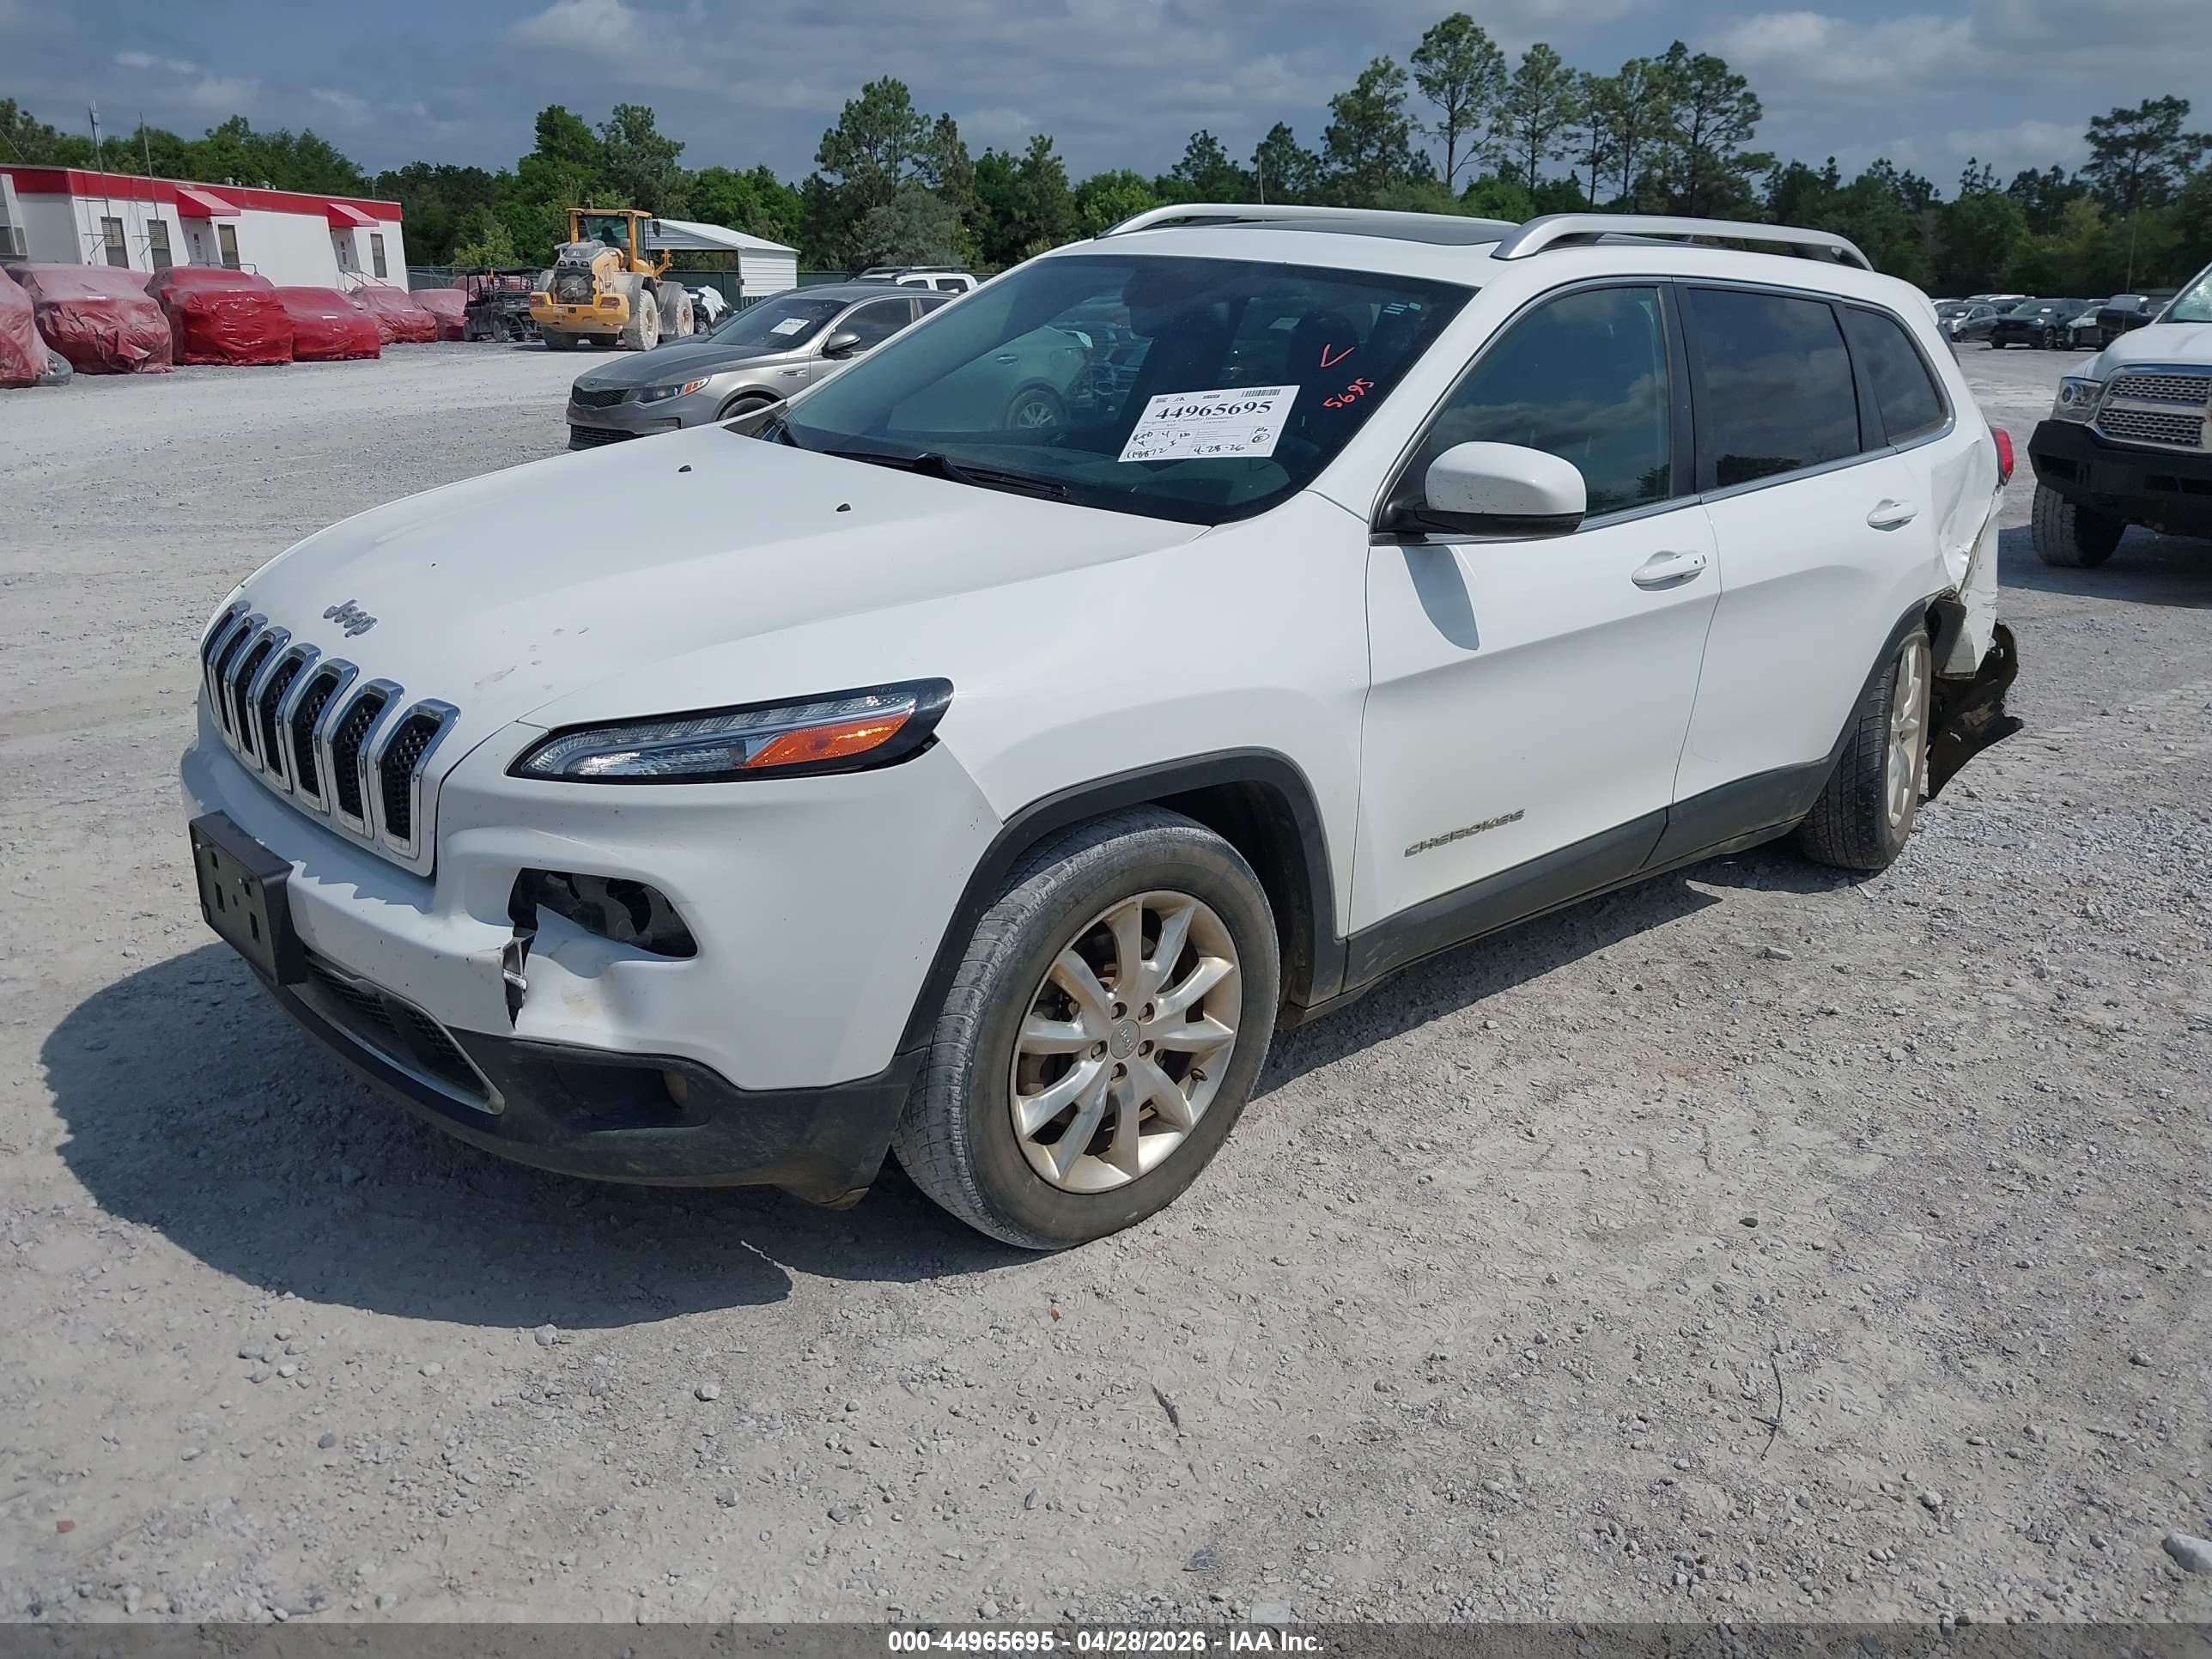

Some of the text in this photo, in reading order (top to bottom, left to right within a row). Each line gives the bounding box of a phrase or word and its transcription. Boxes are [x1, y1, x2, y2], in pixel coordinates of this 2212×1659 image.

[1154, 400, 1274, 420] 44965695
[1322, 378, 1375, 408] 5695
[323, 599, 378, 638] Jeep
[1404, 809, 1525, 857] CHEROKEE
